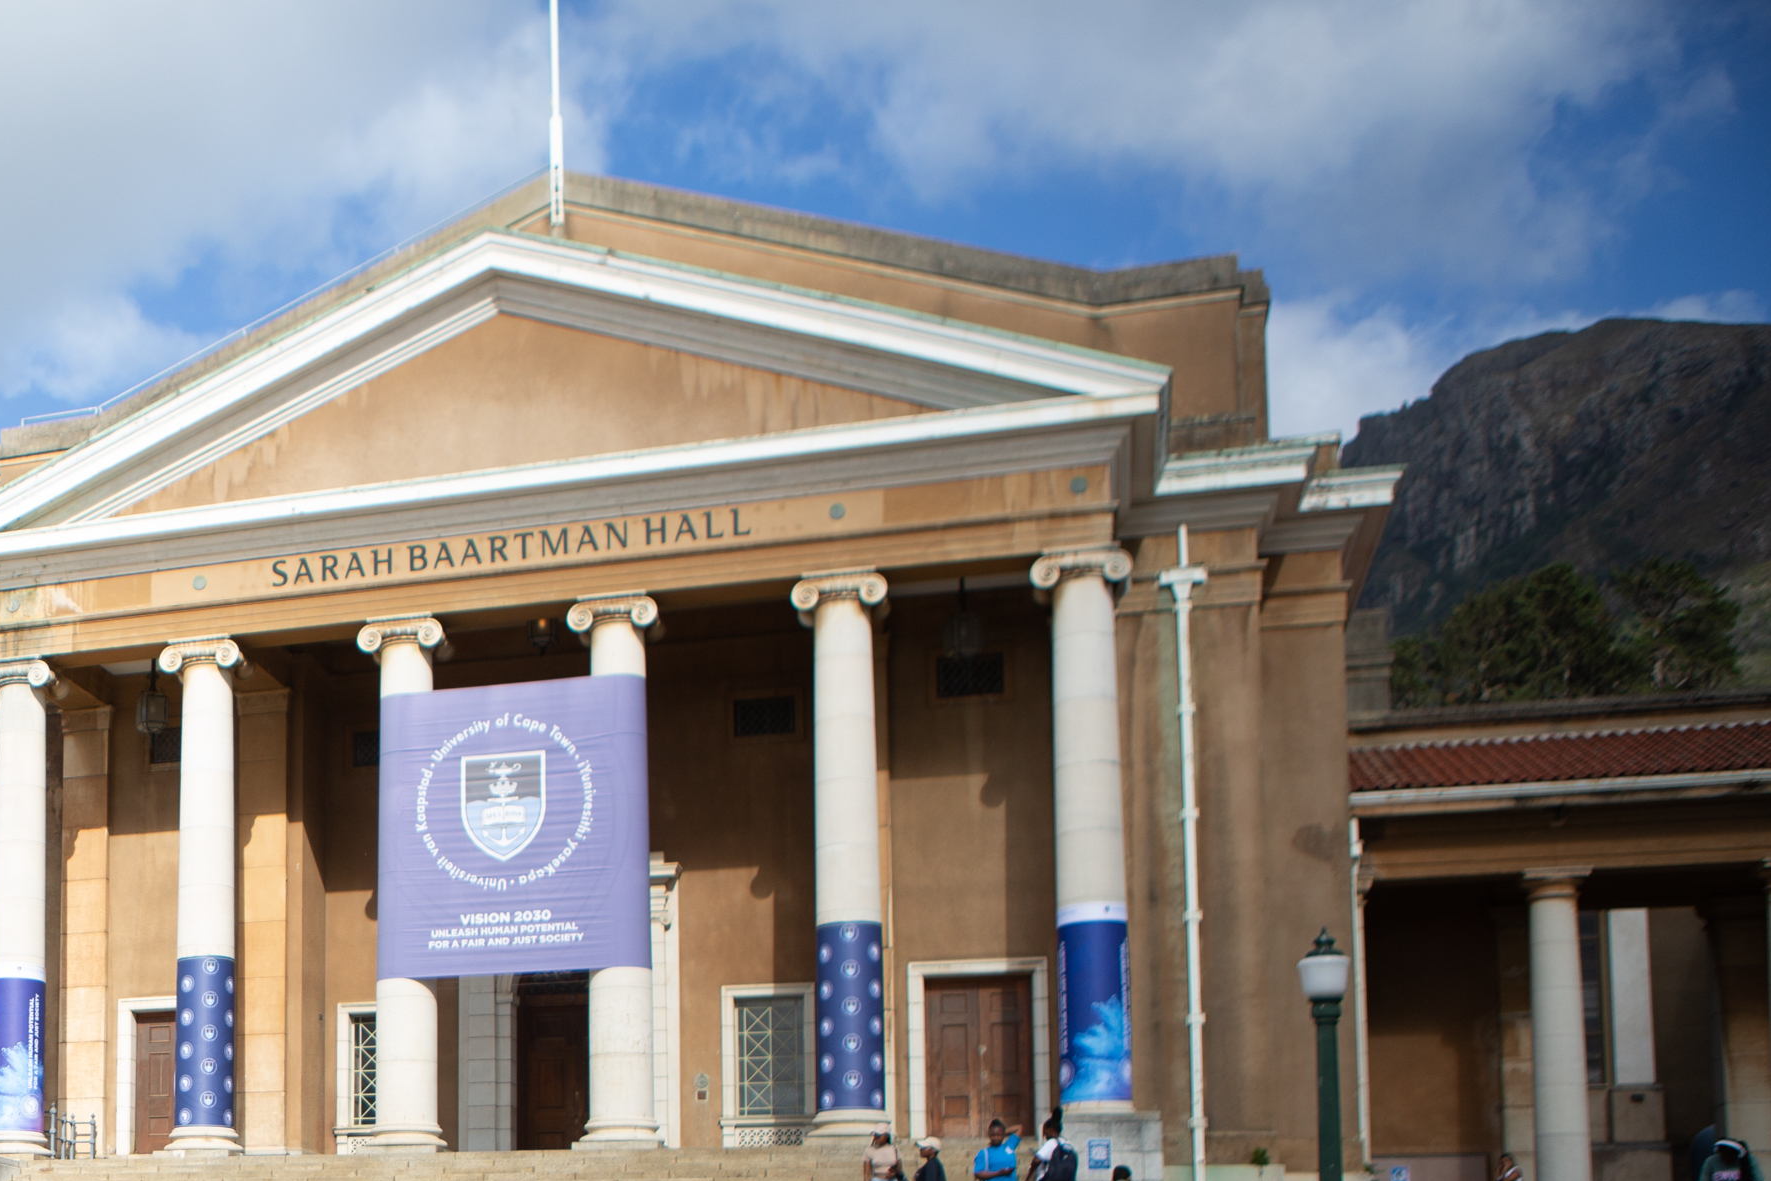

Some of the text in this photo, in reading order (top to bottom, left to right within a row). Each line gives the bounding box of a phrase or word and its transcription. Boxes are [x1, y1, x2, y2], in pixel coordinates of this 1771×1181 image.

[272, 508, 751, 587] SARAH BAARTMAN HALL
[431, 712, 577, 762] University of Cape Town
[415, 767, 507, 891] Universiteit van Kaapstad
[519, 838, 578, 885] yaseKapa
[428, 932, 584, 949] FOR A FAIR AND JUST SOCIETY
[431, 922, 579, 938] UNLEASH HUMAN POTENTIAL
[460, 909, 551, 925] VISION 2030
